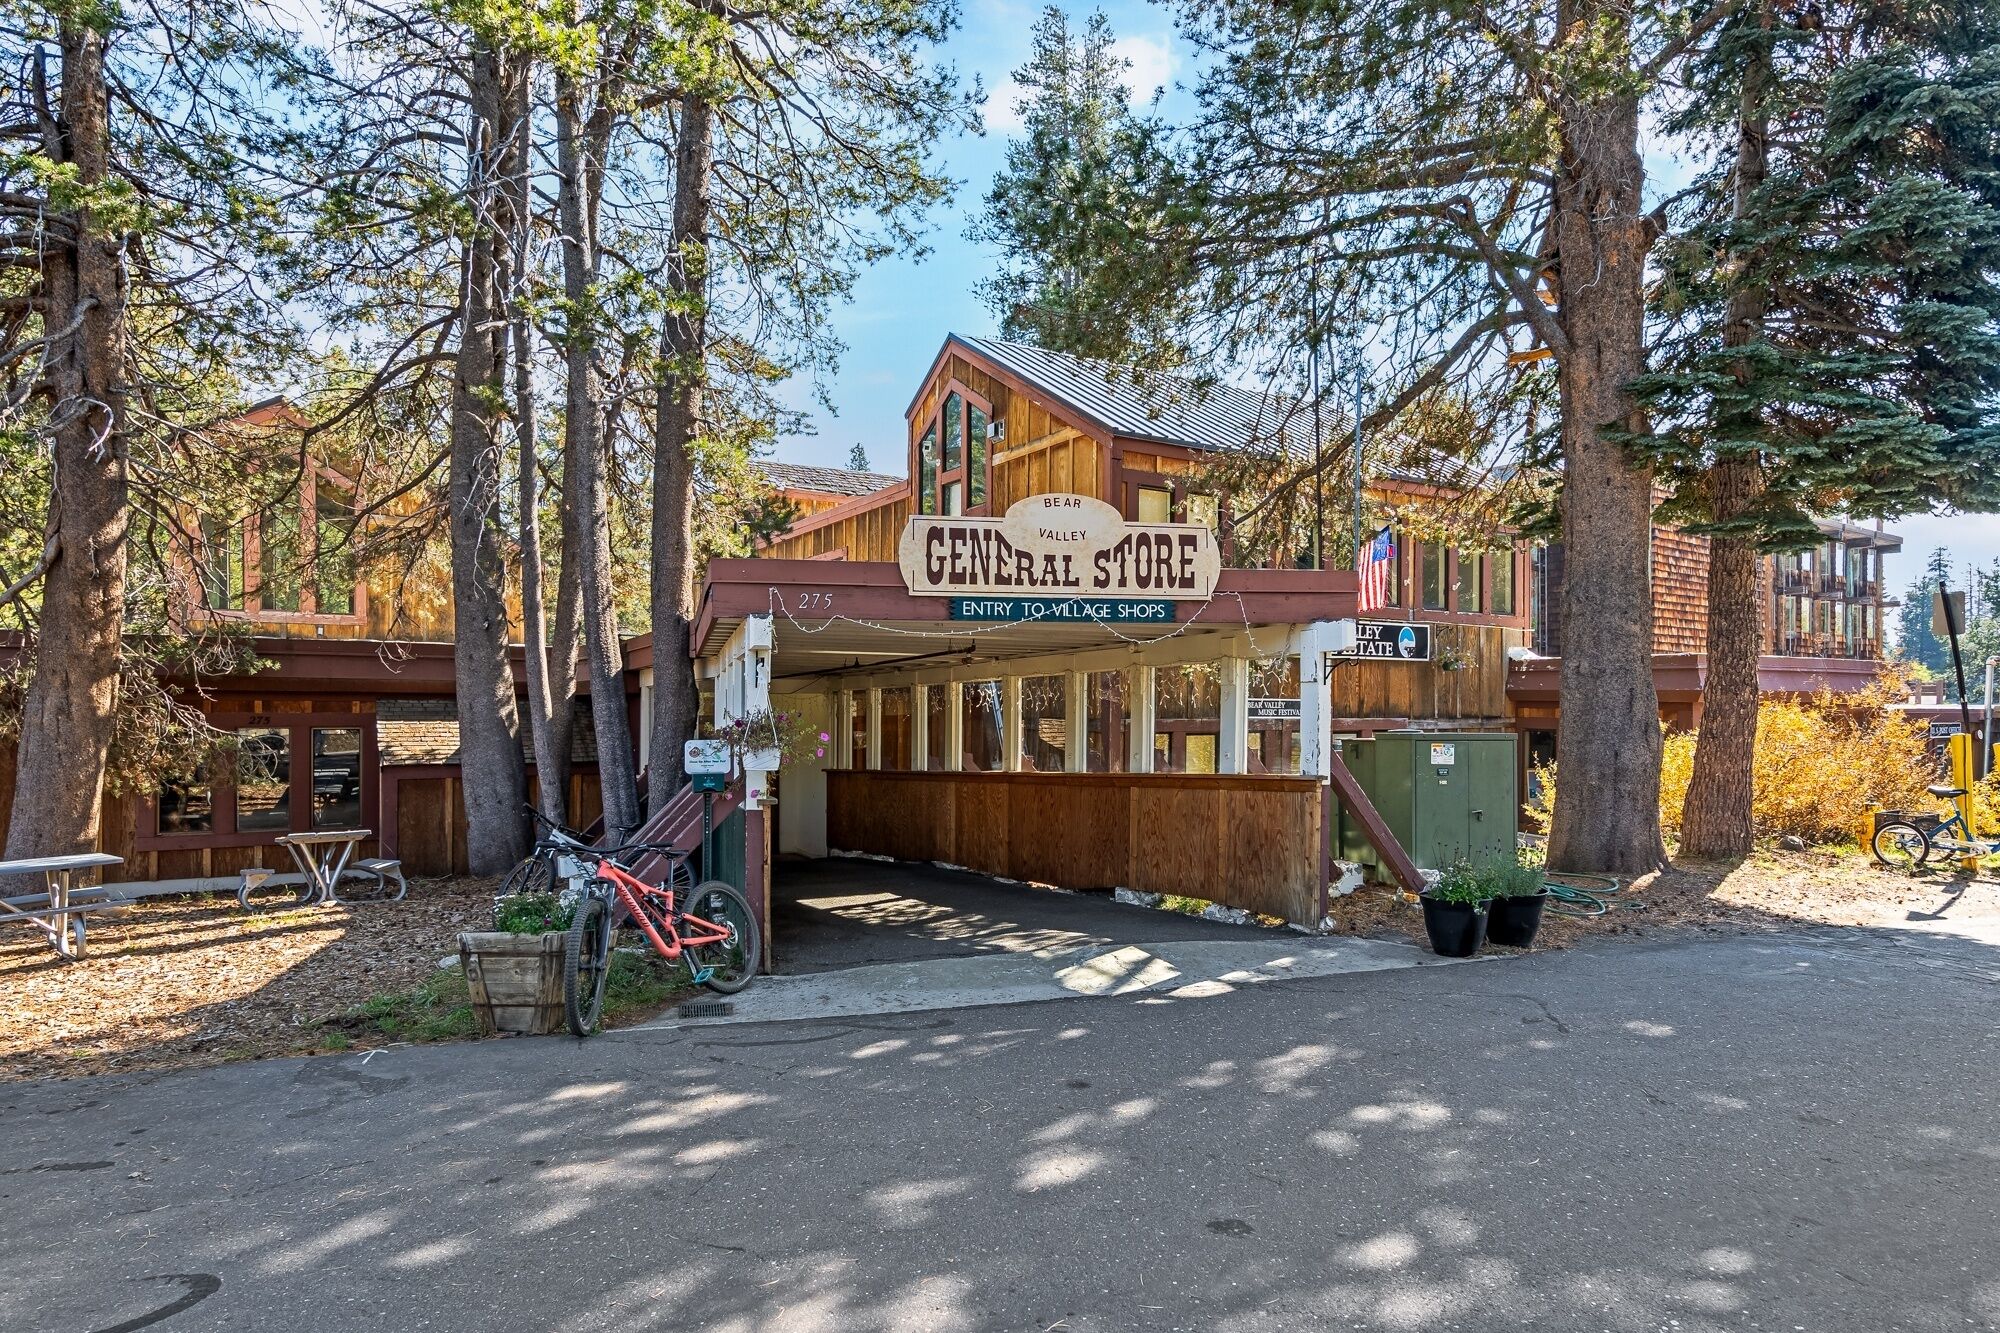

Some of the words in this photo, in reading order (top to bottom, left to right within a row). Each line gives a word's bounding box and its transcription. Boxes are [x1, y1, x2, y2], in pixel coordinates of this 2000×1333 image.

[1043, 497, 1081, 509] BEAR
[1039, 527, 1087, 542] VALLEY
[925, 525, 1080, 587] GENERAL
[1092, 531, 1198, 590] STORE
[798, 592, 833, 610] 275
[962, 601, 1013, 616] ENTRY
[1021, 602, 1045, 617] TO
[1052, 603, 1112, 618] VILLAGE
[1117, 603, 1165, 618] SHOPS
[1355, 624, 1383, 640] LEY
[249, 715, 271, 725] 275
[1257, 708, 1277, 716] MUSIC
[1278, 708, 1300, 716] FESTIVA
[619, 885, 650, 928] SPECIALIZED
